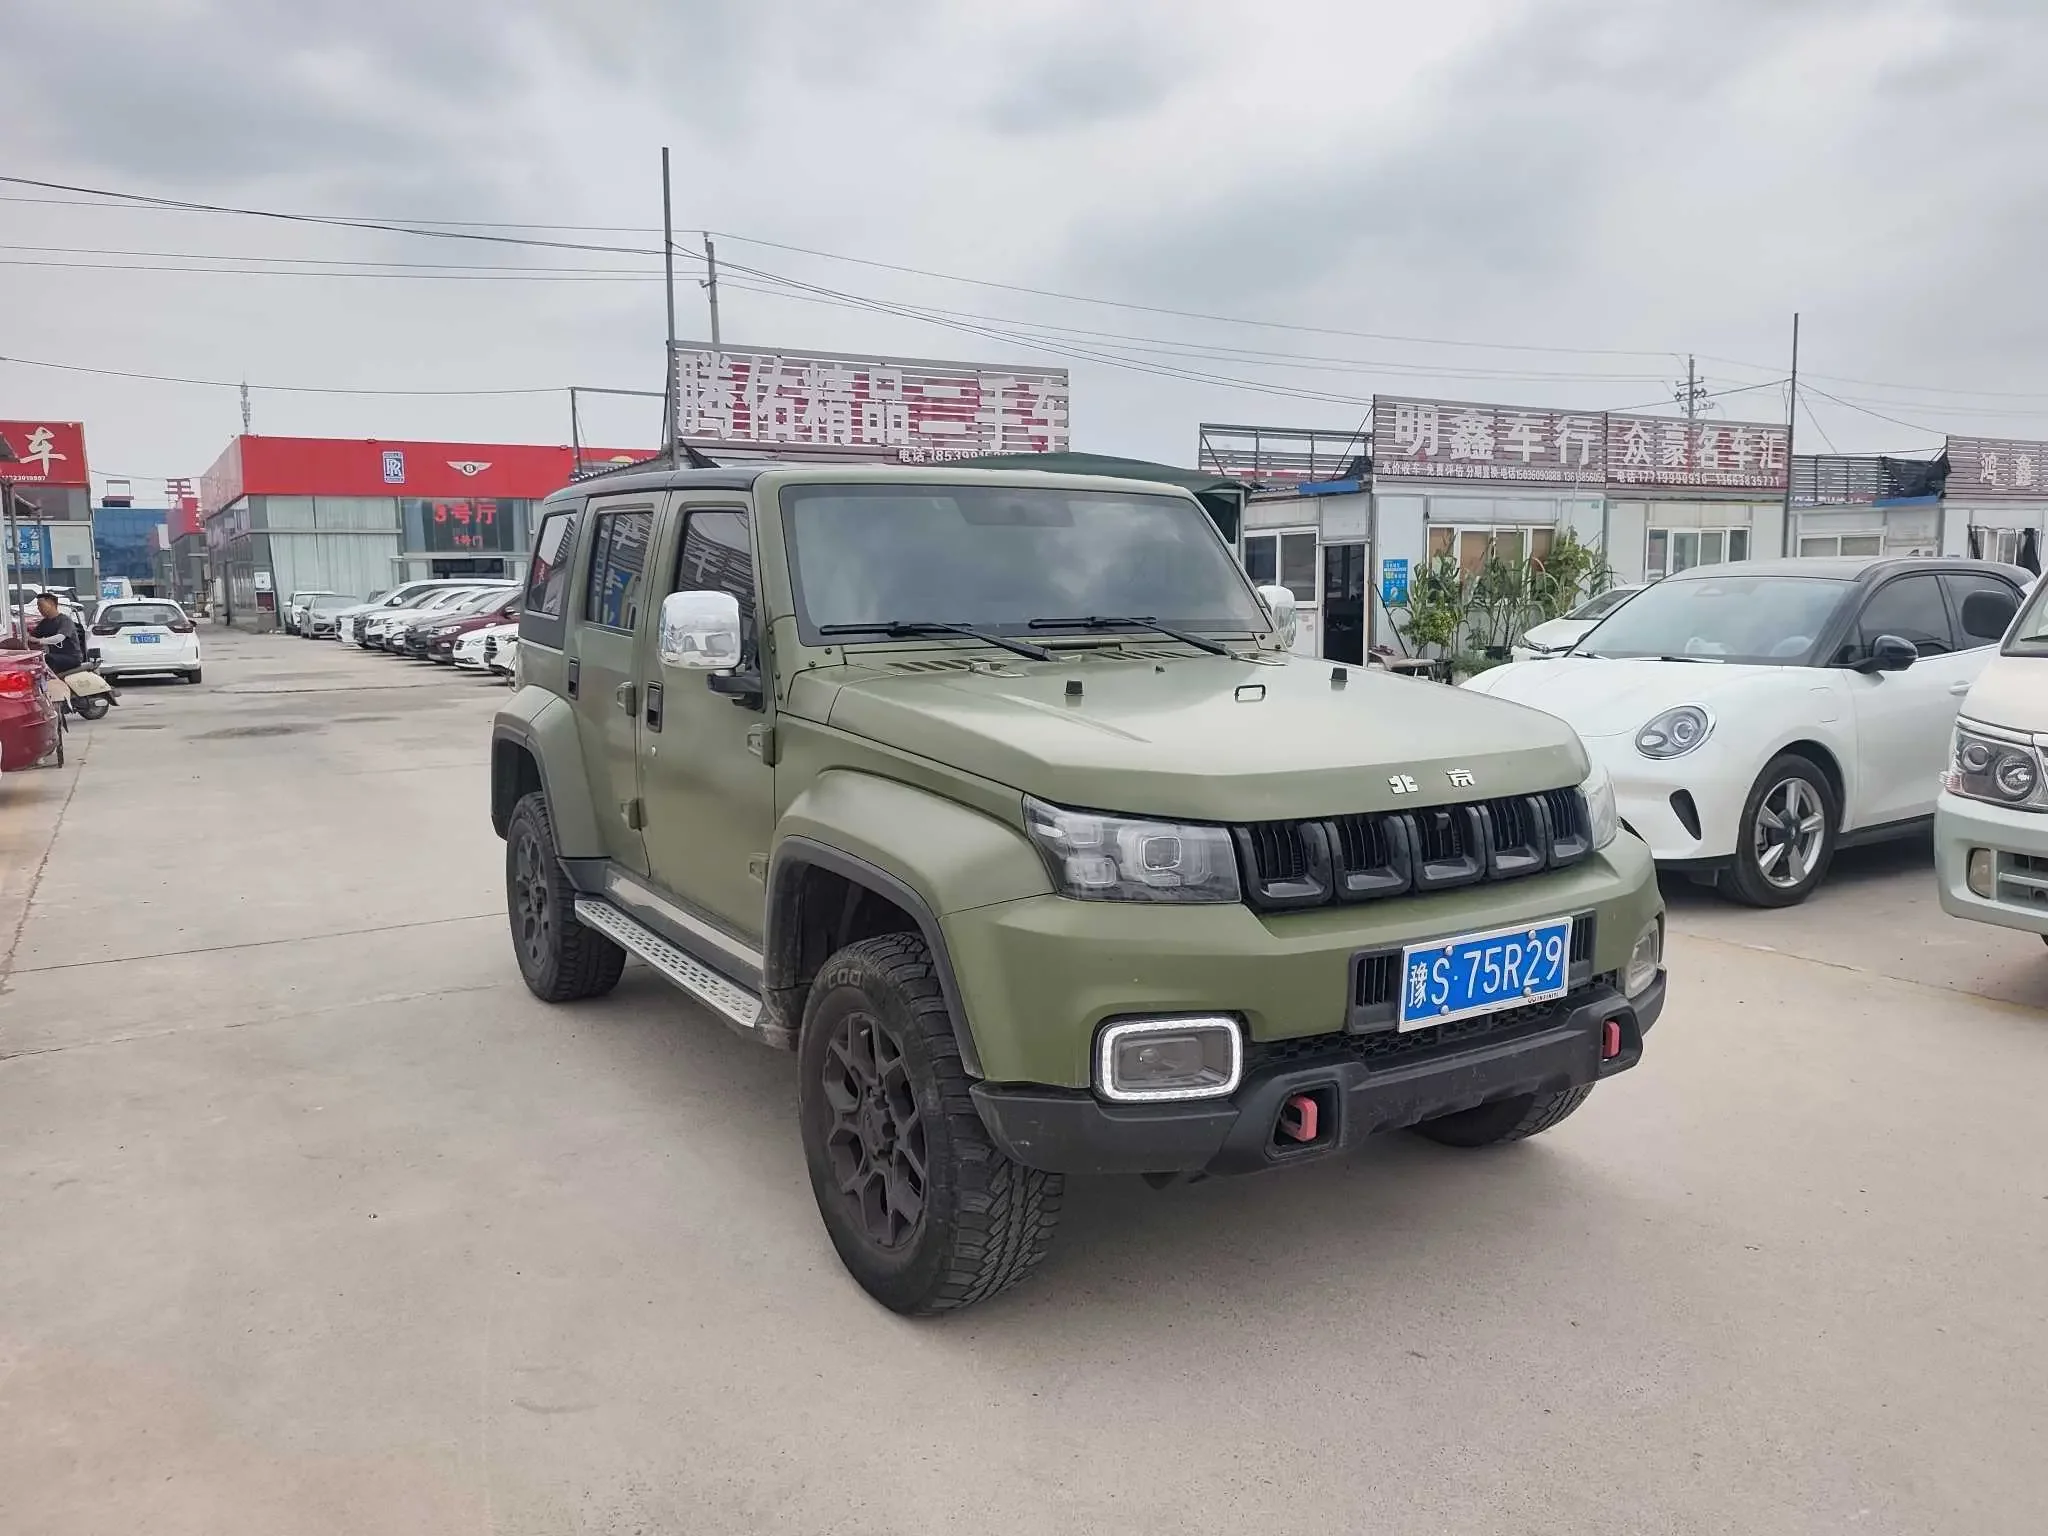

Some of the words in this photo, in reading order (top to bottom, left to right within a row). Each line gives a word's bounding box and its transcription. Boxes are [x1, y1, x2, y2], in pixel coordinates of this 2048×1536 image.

[678, 352, 1069, 452] 腾佑精品二手车
[1395, 405, 1598, 465] 明鑫车行
[1623, 421, 1785, 470] 众豪名车汇
[1388, 768, 1476, 794] 北京
